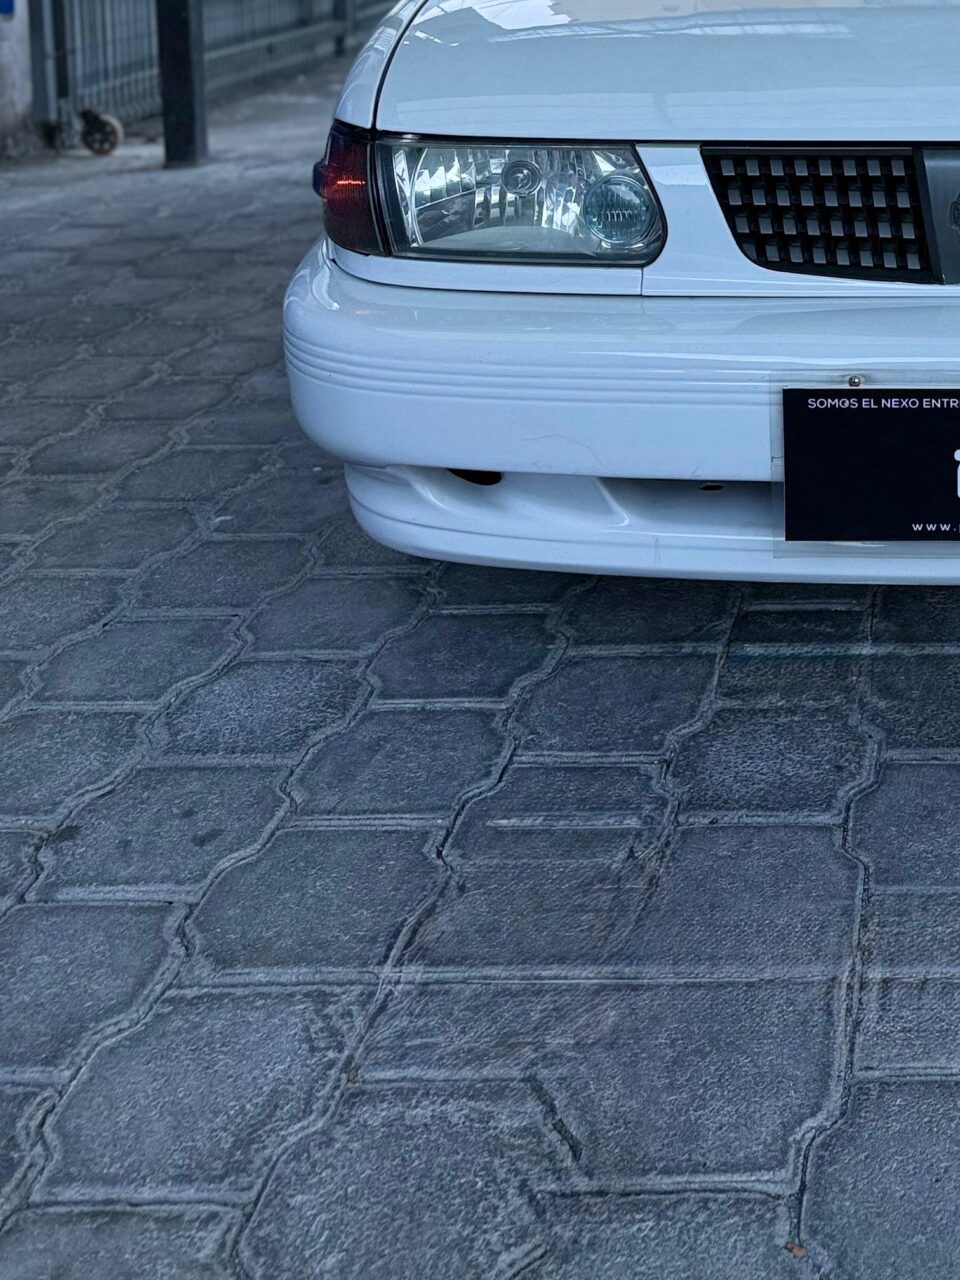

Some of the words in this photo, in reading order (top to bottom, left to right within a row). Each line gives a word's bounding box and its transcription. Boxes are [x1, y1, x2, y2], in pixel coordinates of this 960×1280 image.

[807, 398, 859, 409] SOMOS
[862, 398, 878, 409] EL
[881, 398, 919, 409] NEXO
